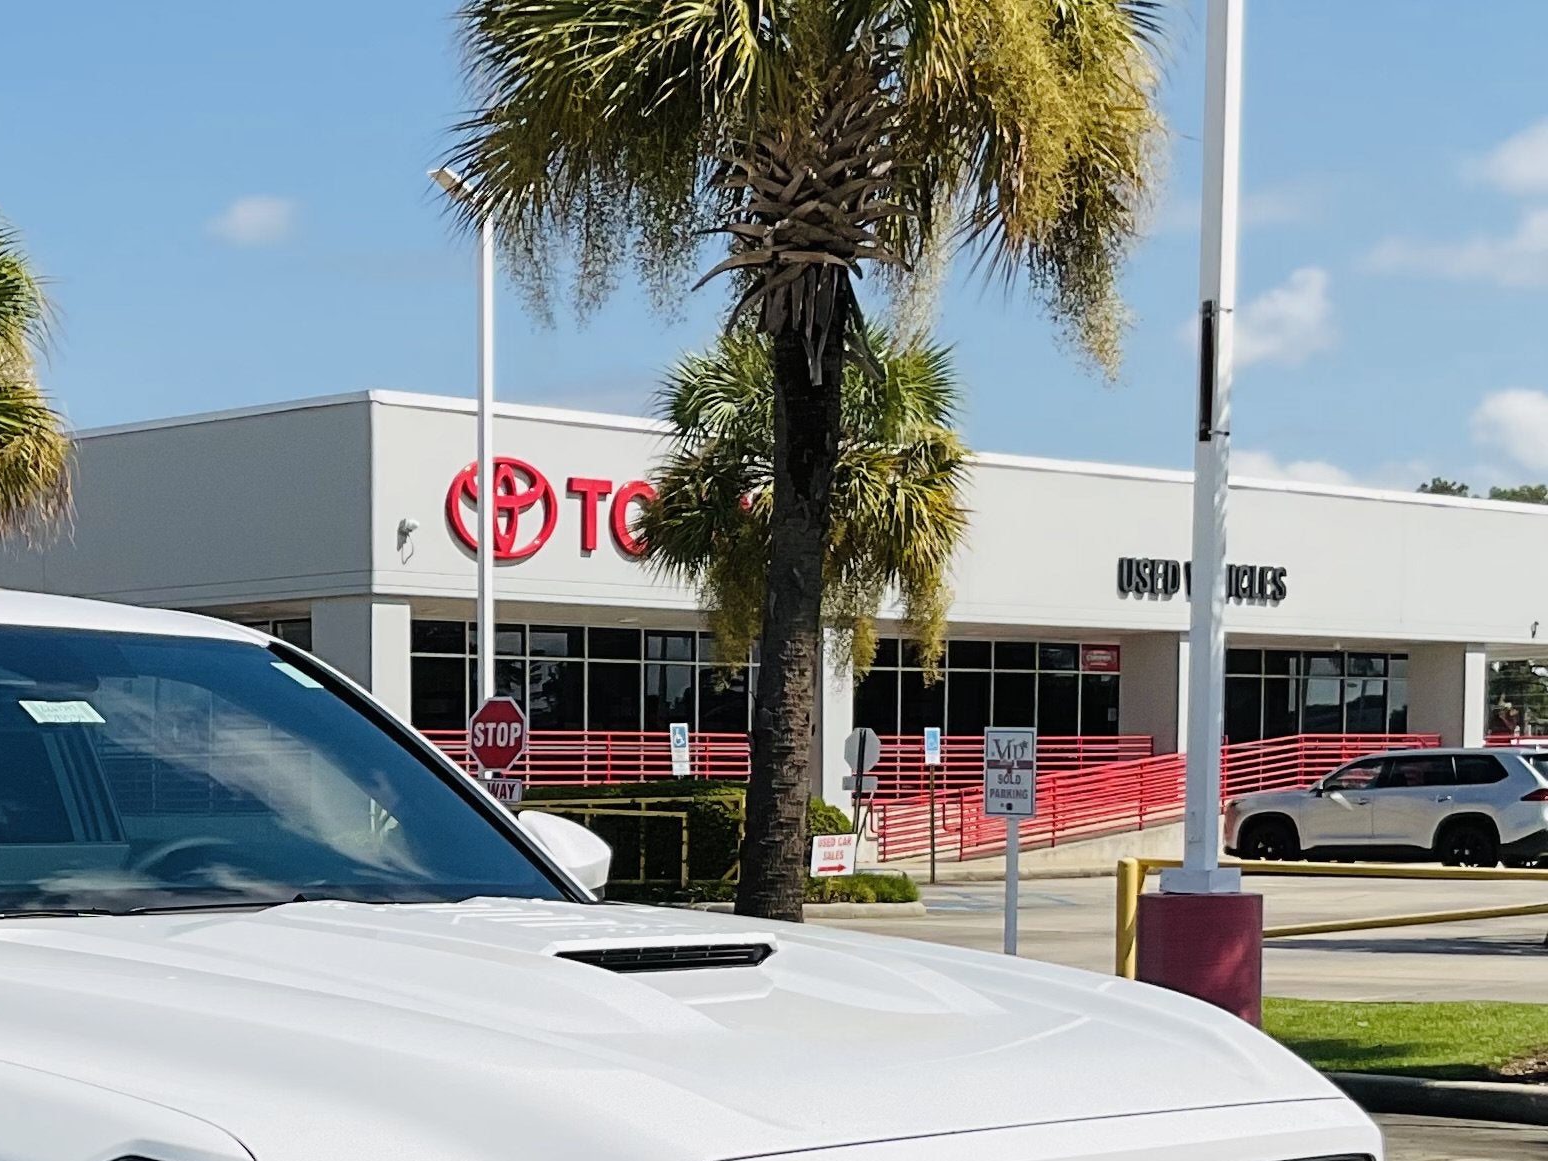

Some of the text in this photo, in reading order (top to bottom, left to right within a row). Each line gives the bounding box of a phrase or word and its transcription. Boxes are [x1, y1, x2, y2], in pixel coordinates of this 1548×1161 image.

[1118, 557, 1180, 595] USED
[473, 721, 522, 748] STOP
[997, 774, 1022, 785] SOLD
[487, 782, 516, 800] WAY
[989, 788, 1029, 799] PARKING
